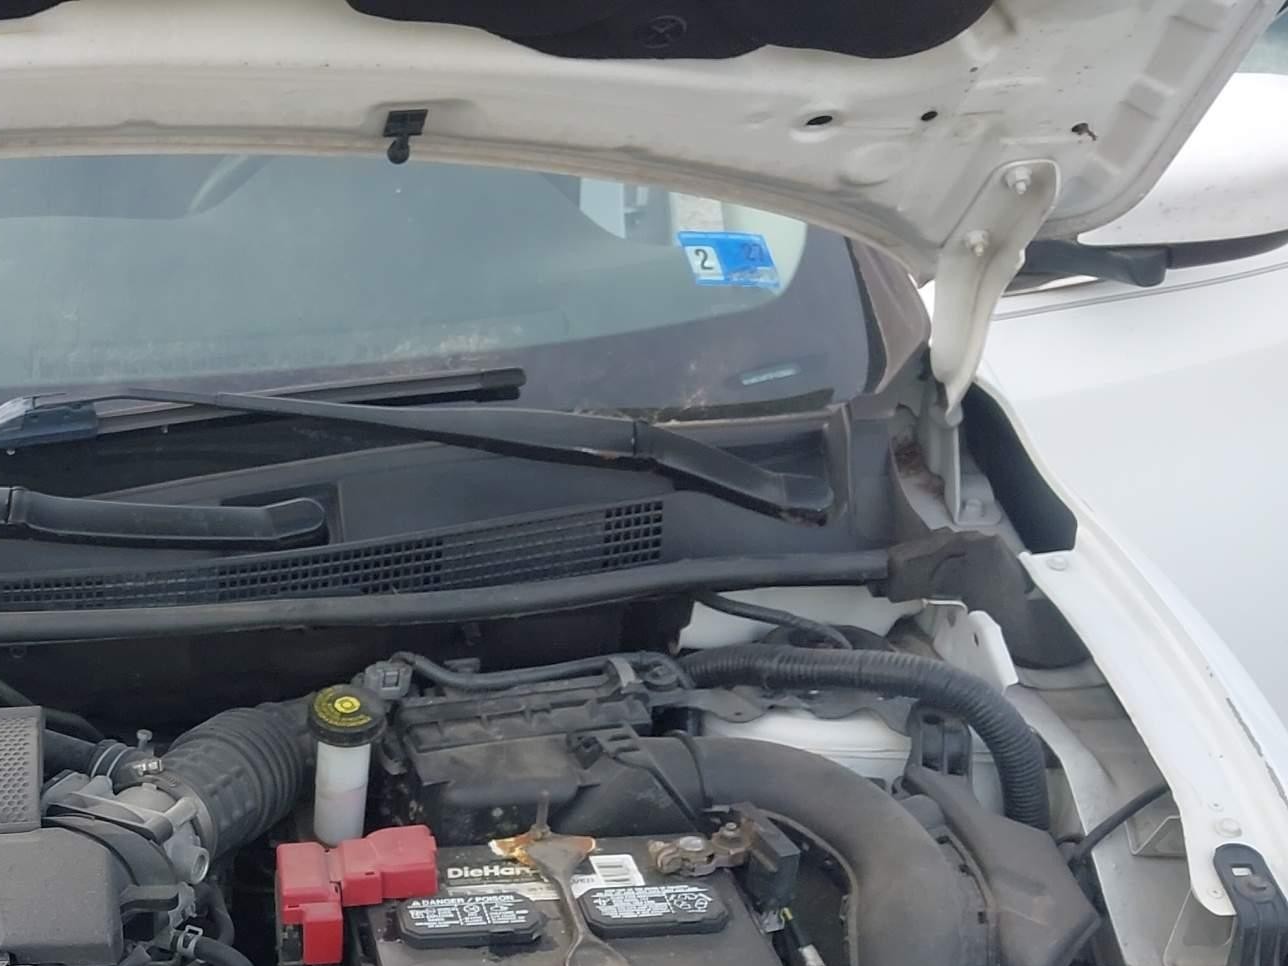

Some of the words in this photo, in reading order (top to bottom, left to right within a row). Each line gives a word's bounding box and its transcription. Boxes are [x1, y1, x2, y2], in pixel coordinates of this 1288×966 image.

[694, 248, 715, 271] 2
[447, 864, 534, 879] DieHar
[423, 897, 465, 907] DANGER
[475, 895, 515, 904] POISON
